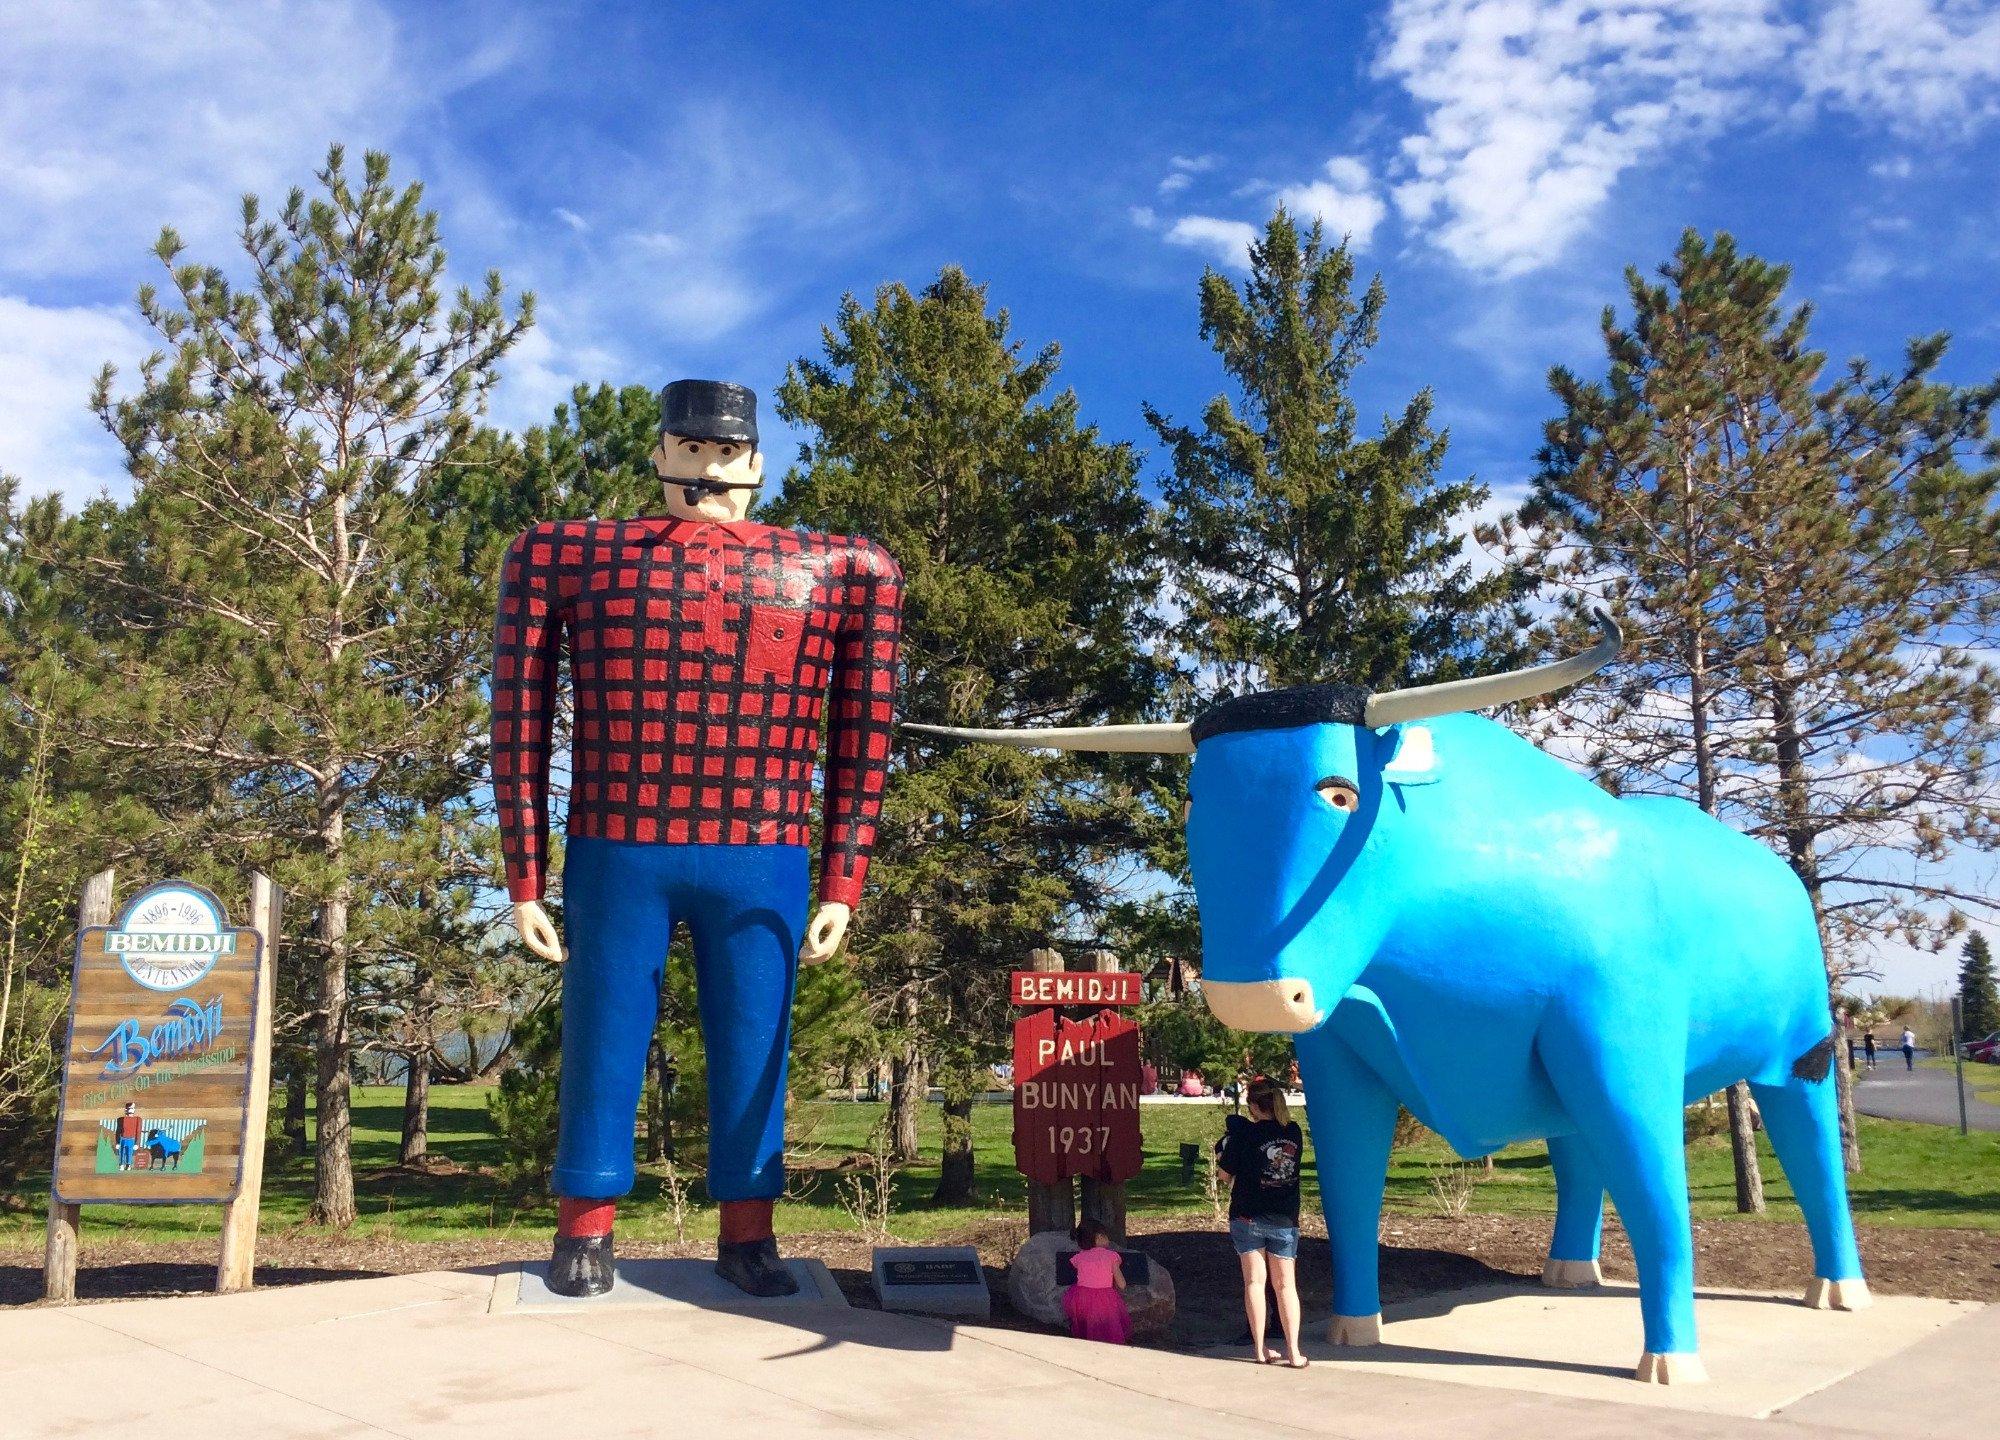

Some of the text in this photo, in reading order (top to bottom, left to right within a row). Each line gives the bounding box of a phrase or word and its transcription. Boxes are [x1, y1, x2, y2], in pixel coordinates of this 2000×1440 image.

[108, 933, 231, 953] BEMIDJI
[1020, 977, 1128, 1001] BEMIDJI
[81, 993, 224, 1073] Bemidji
[1038, 1039, 1115, 1066] PAUL
[1021, 1082, 1138, 1110] BUNYAN
[1048, 1126, 1111, 1155] 1937
